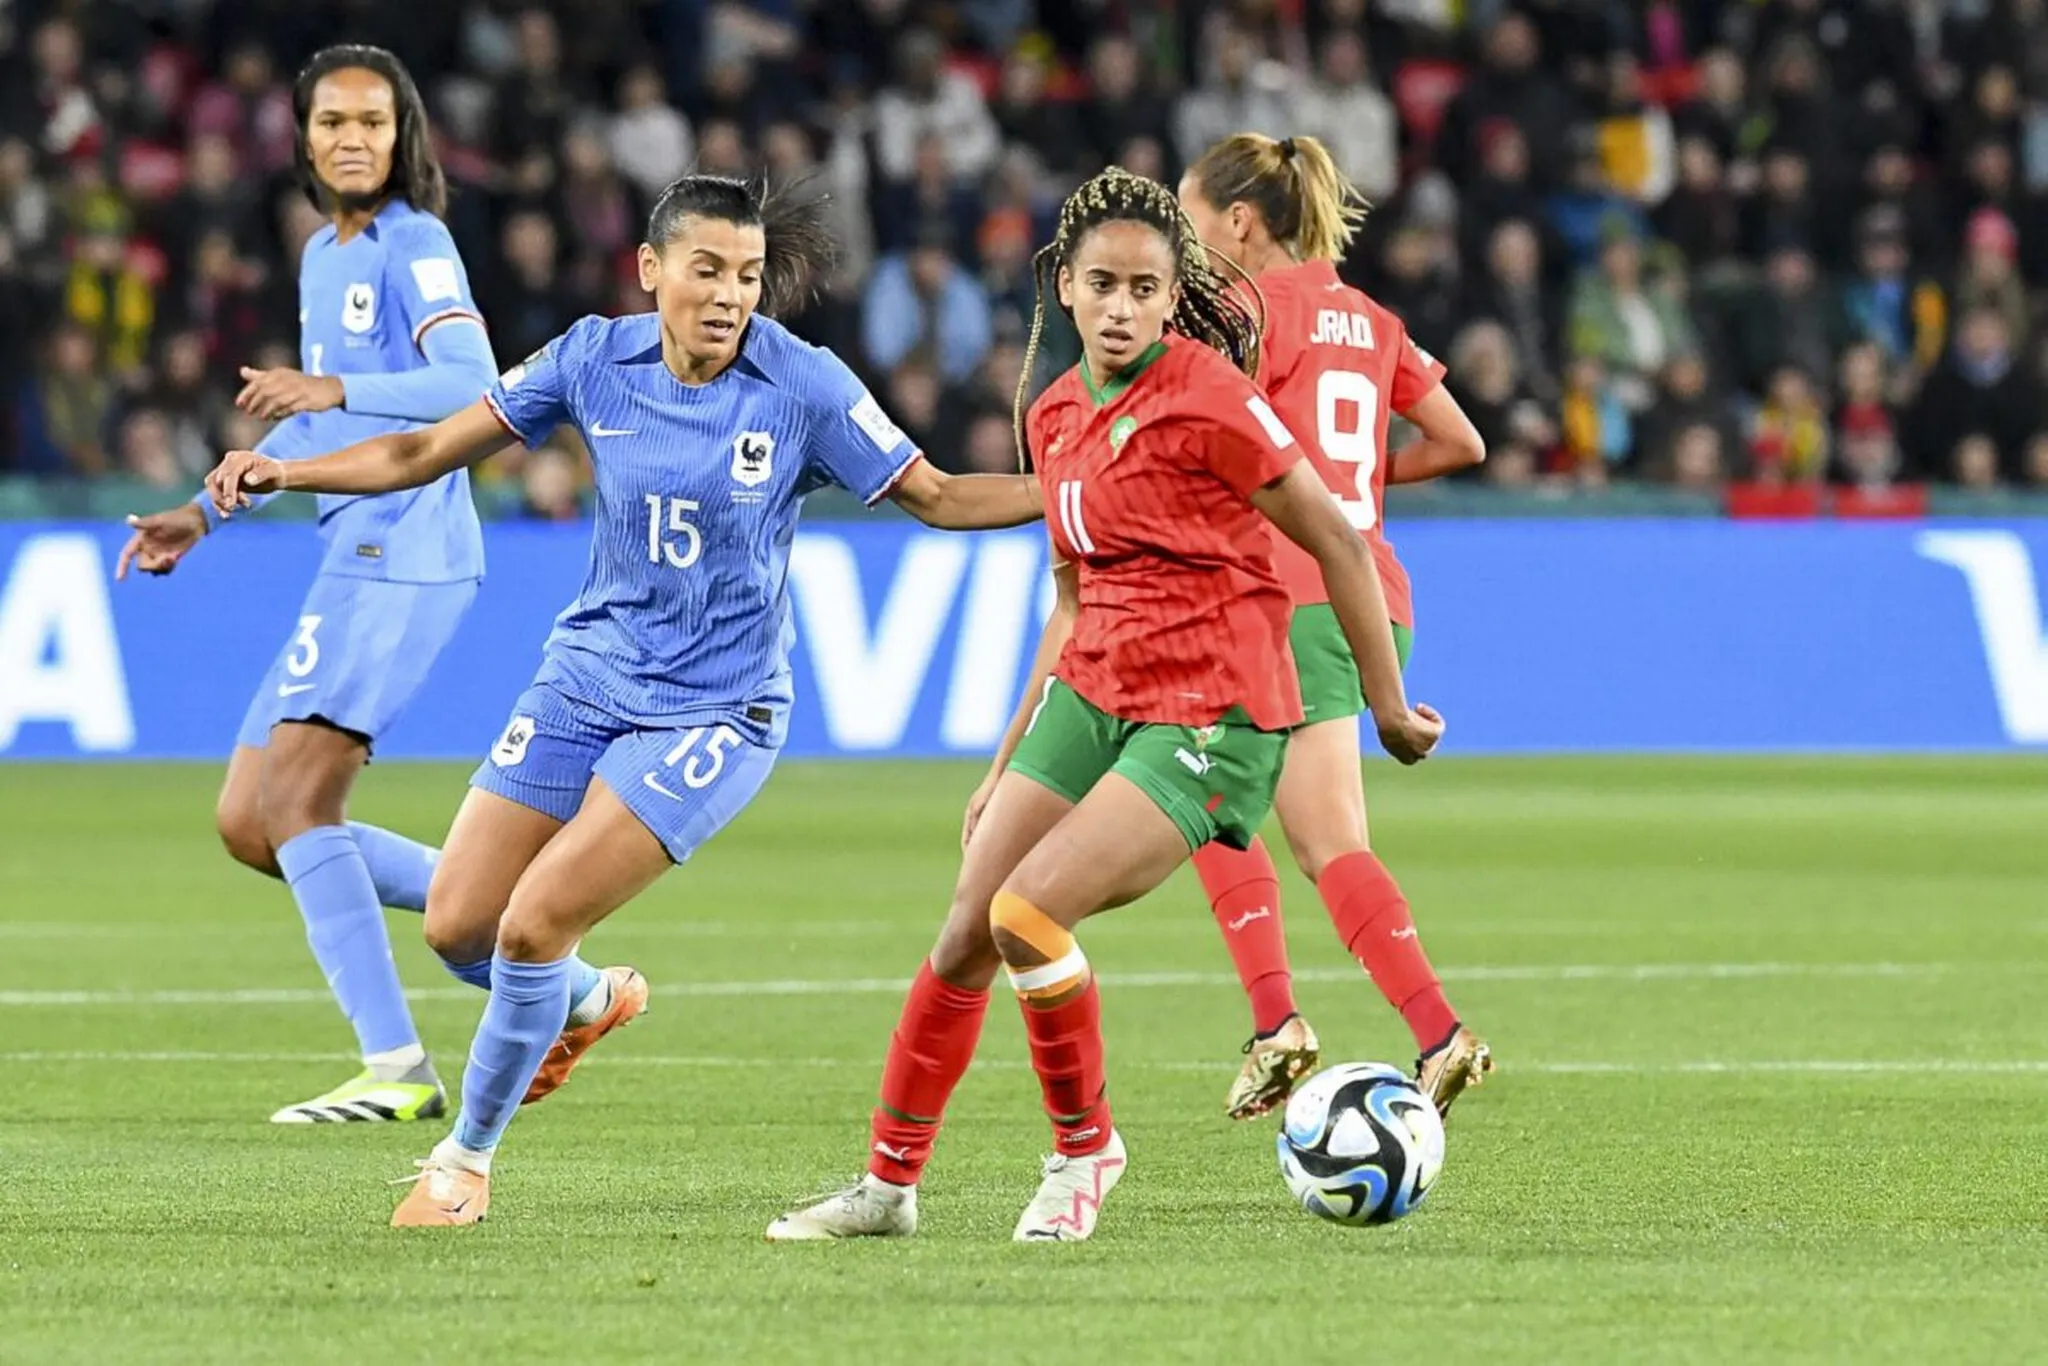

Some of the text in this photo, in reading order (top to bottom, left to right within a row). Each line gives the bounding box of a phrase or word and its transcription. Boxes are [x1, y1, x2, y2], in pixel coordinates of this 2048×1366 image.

[1317, 370, 1378, 530] 9
[645, 494, 701, 568] 15
[1059, 480, 1096, 554] 11
[0, 533, 137, 751] A
[287, 614, 322, 677] 3
[790, 532, 1057, 750] VI
[664, 725, 744, 788] 15
